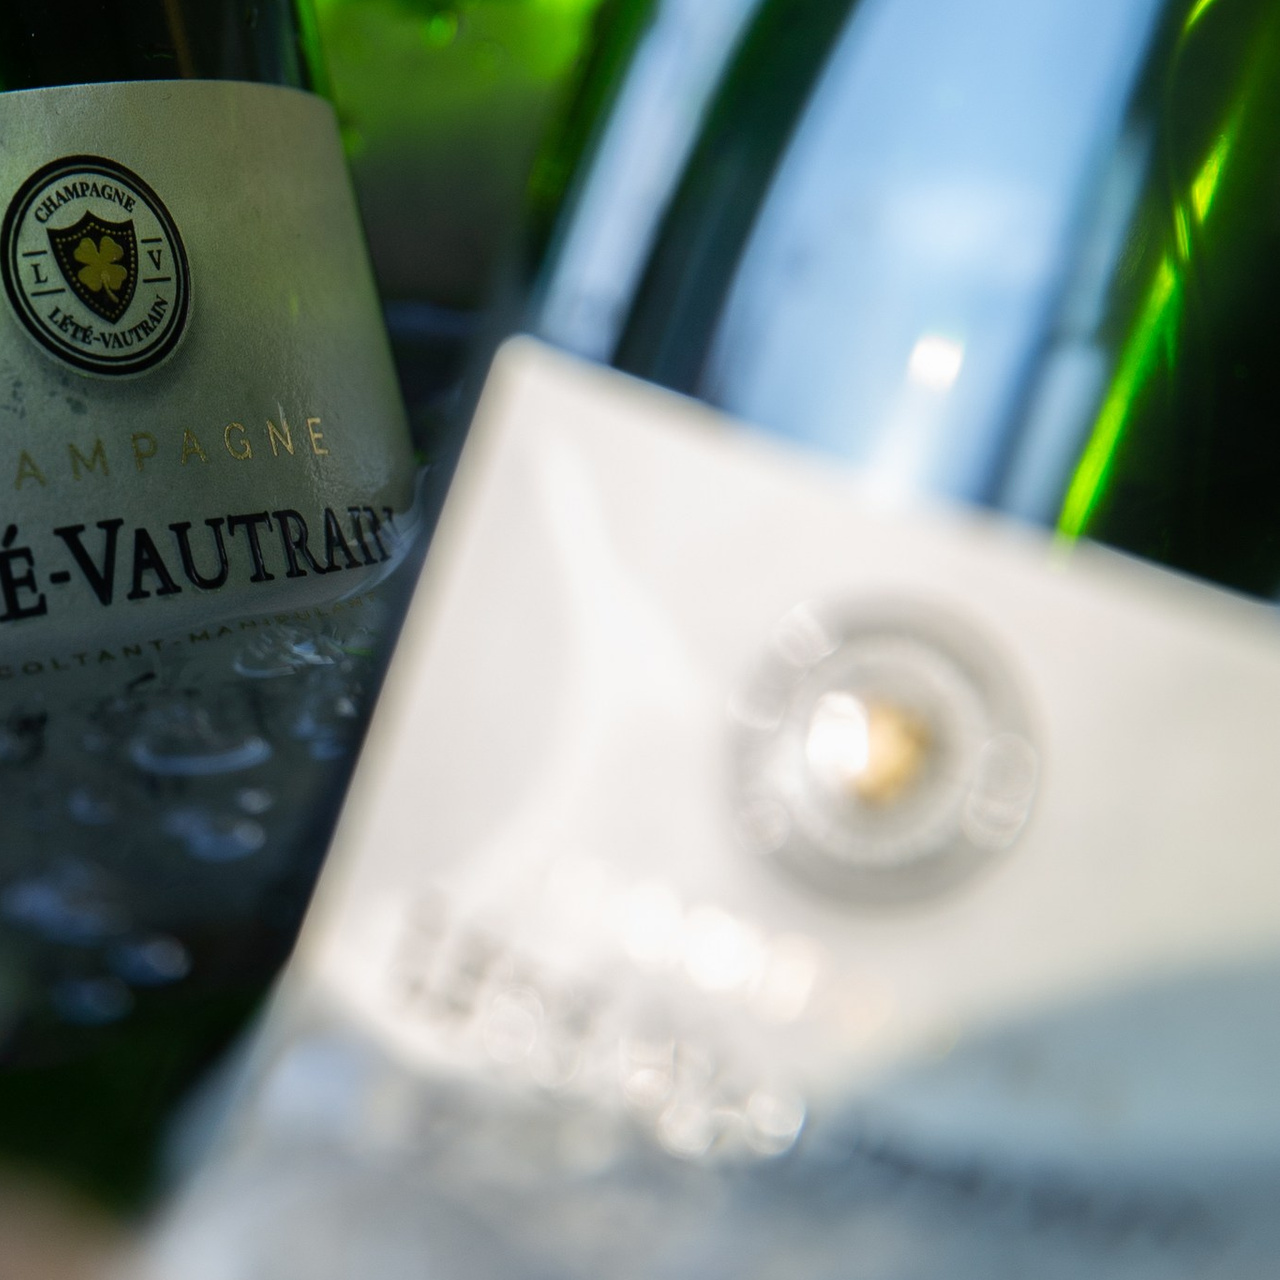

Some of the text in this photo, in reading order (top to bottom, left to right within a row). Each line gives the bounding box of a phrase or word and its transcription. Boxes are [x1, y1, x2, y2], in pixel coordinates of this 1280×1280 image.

[34, 181, 137, 224] CHAMPAGNE
[30, 249, 162, 284] L V
[47, 294, 169, 350] LÉTÉ-VAUTRAIN
